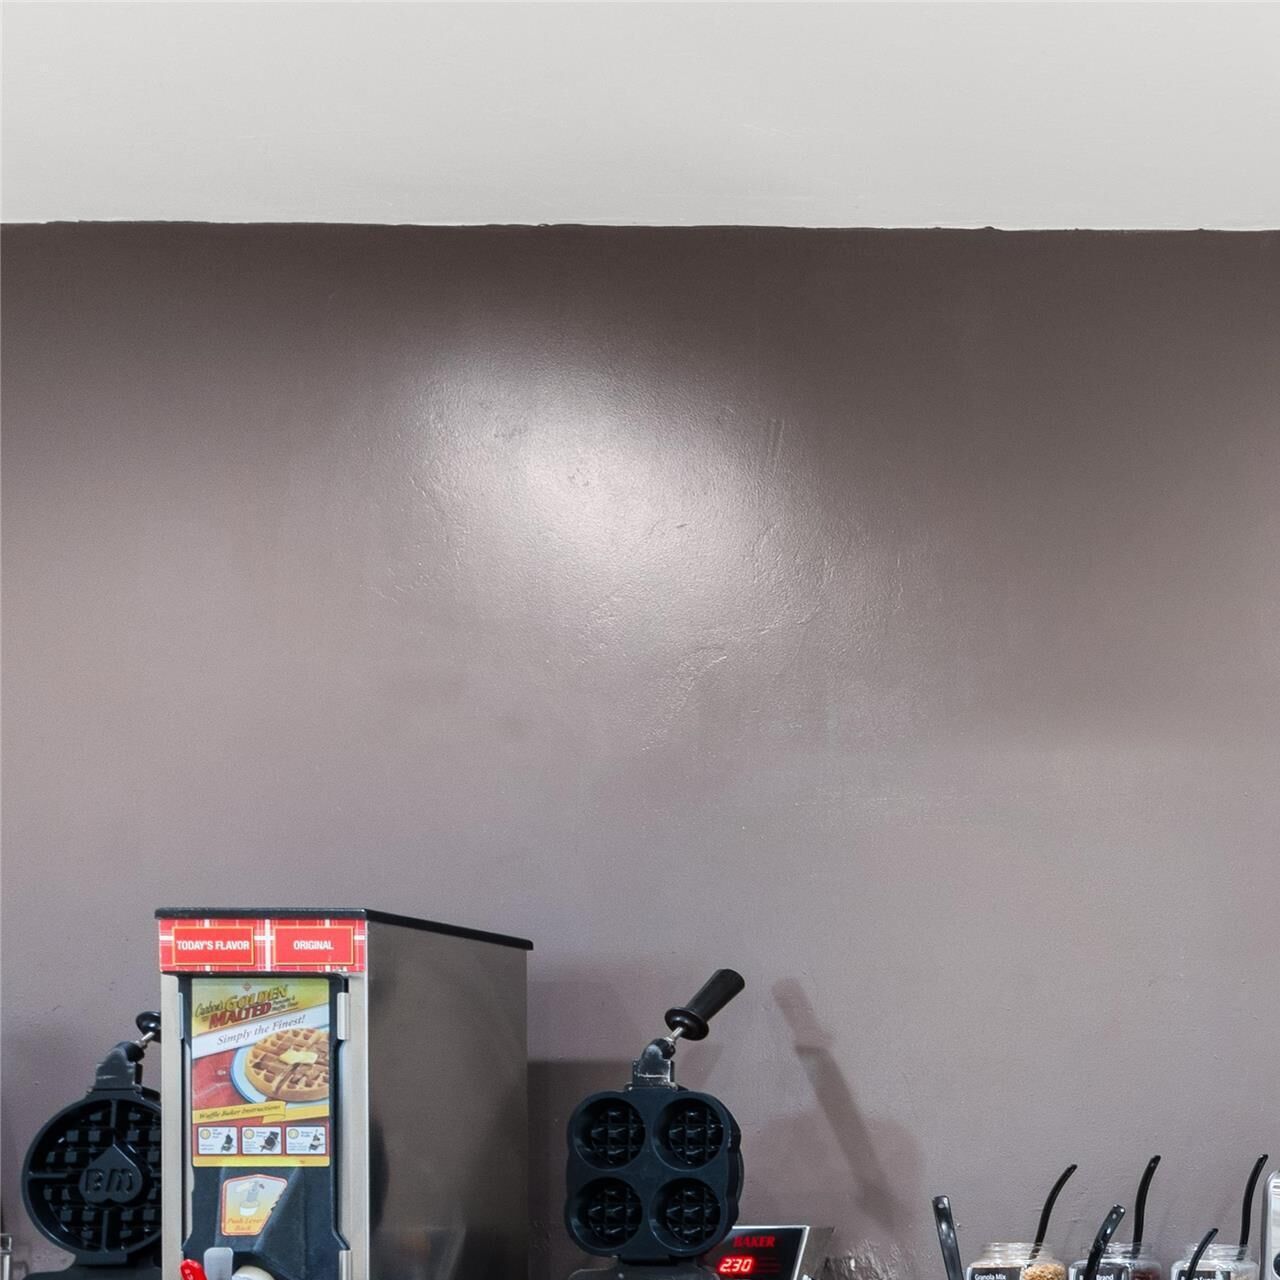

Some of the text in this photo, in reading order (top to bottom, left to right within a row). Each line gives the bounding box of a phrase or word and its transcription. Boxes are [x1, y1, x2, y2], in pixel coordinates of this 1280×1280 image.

[176, 940, 250, 950] TODAY'S FLAVOR
[293, 940, 335, 950] ORIGINAL
[209, 1002, 272, 1029] MALTED
[217, 1015, 307, 1045] Simply the Finest!
[734, 1236, 776, 1247] BAKER
[974, 1273, 1006, 1280] Granola Mix
